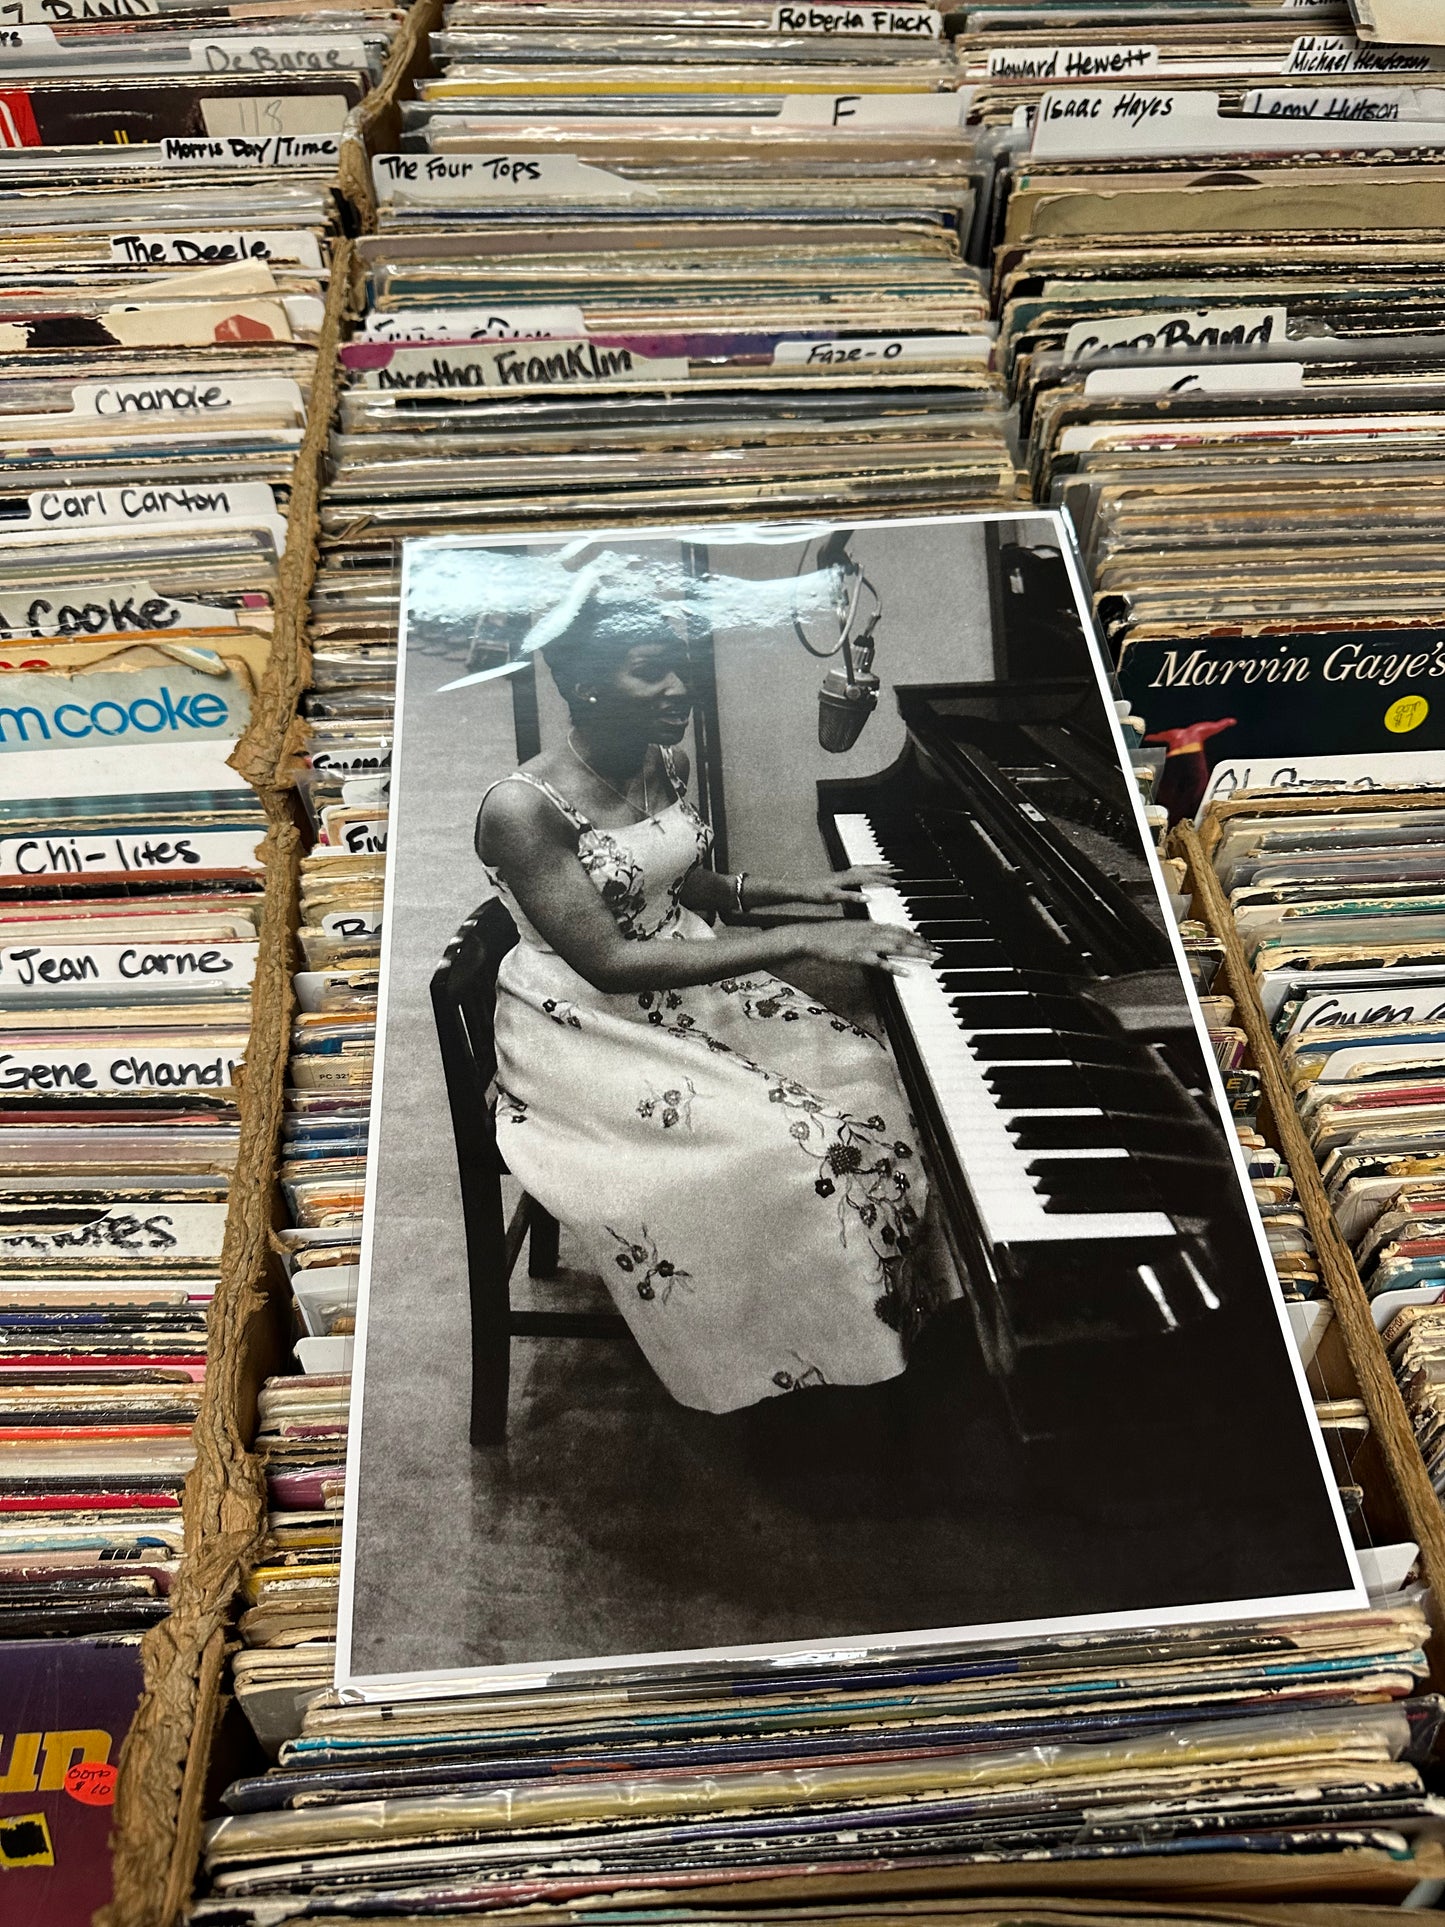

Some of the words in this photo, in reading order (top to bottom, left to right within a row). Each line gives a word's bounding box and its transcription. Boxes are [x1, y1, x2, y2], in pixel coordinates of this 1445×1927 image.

[779, 8, 864, 31] Roberta
[991, 50, 1058, 77] Howard
[1065, 49, 1151, 76] Hewett
[1290, 51, 1352, 73] Michael
[1353, 50, 1431, 70] Henderson
[832, 96, 861, 126] F
[1043, 96, 1102, 122] Isaac
[1112, 92, 1174, 128] Hayes
[166, 139, 224, 160] Morris
[379, 157, 418, 180] The
[427, 157, 473, 179] Four
[482, 157, 541, 183] Tops
[113, 236, 166, 263] The
[172, 236, 271, 262] Deele
[40, 491, 106, 521] Carl
[1148, 645, 1312, 688] Marvin
[1322, 641, 1445, 687] Gaye's
[10, 948, 99, 987] Jean
[118, 949, 234, 979] Carne
[0, 1054, 98, 1090] Gene
